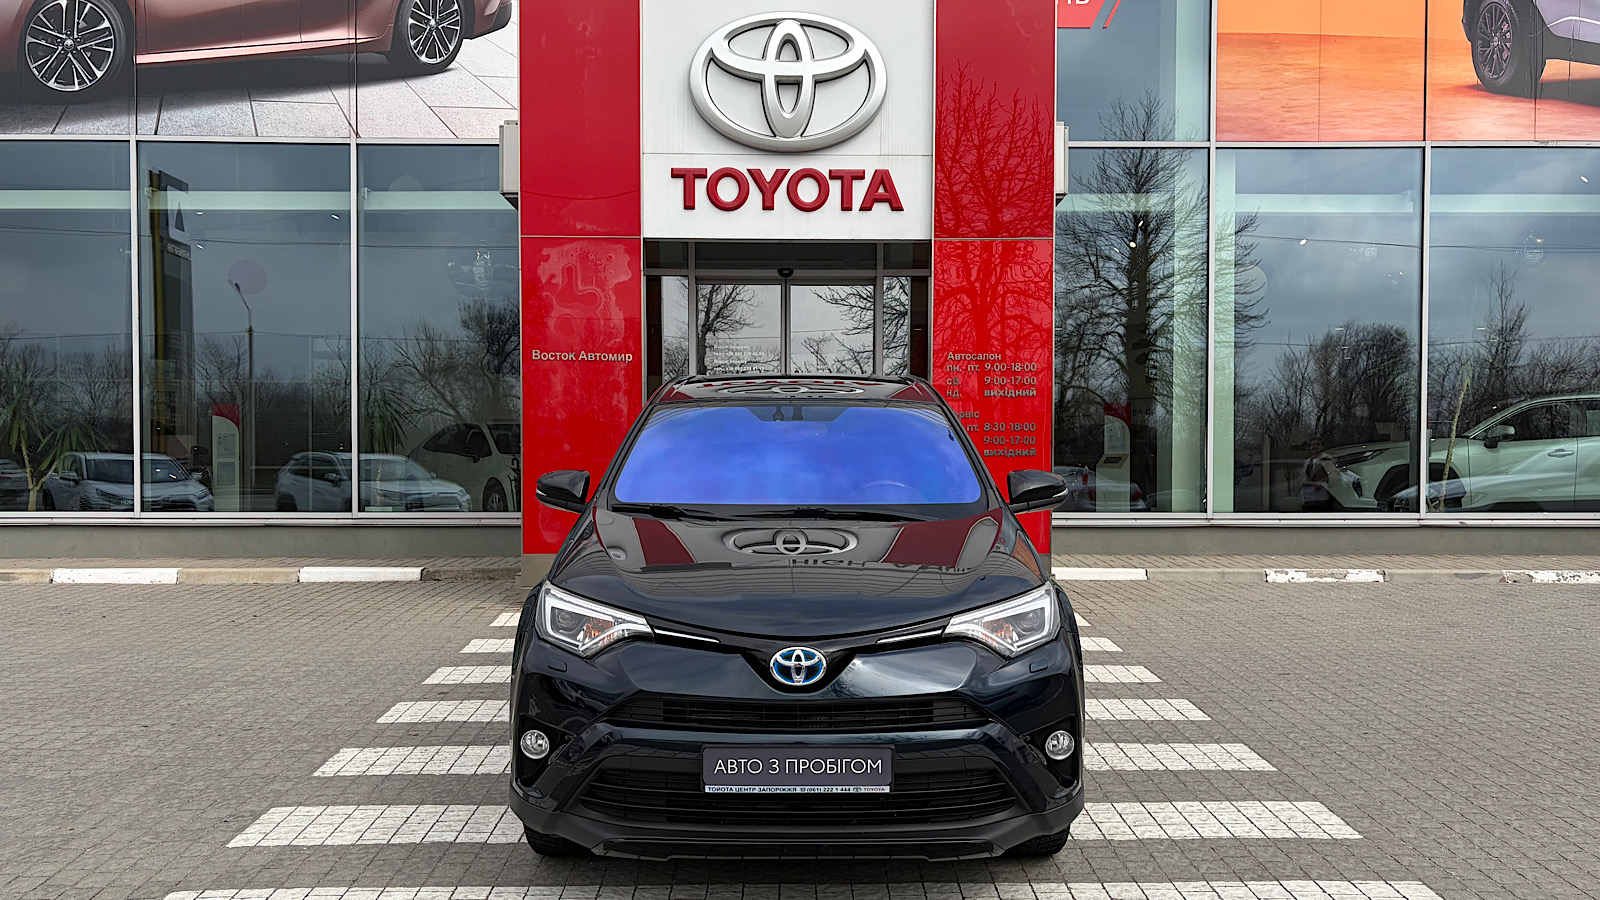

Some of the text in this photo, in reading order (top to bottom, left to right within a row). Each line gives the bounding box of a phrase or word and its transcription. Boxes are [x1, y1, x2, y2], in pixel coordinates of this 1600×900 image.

[671, 167, 904, 212] TOYOTA
[532, 349, 633, 364] Восток Автомир
[946, 352, 1002, 361] Автосалон
[946, 376, 1037, 386] сб. 9:00-17:00
[946, 387, 1037, 399] нд. вихідний
[954, 410, 980, 421] рвіс
[983, 436, 1037, 445] 9:00-17:00
[983, 447, 1037, 458] вихідний
[713, 758, 882, 774] АВТО З ПРОБІГОМ
